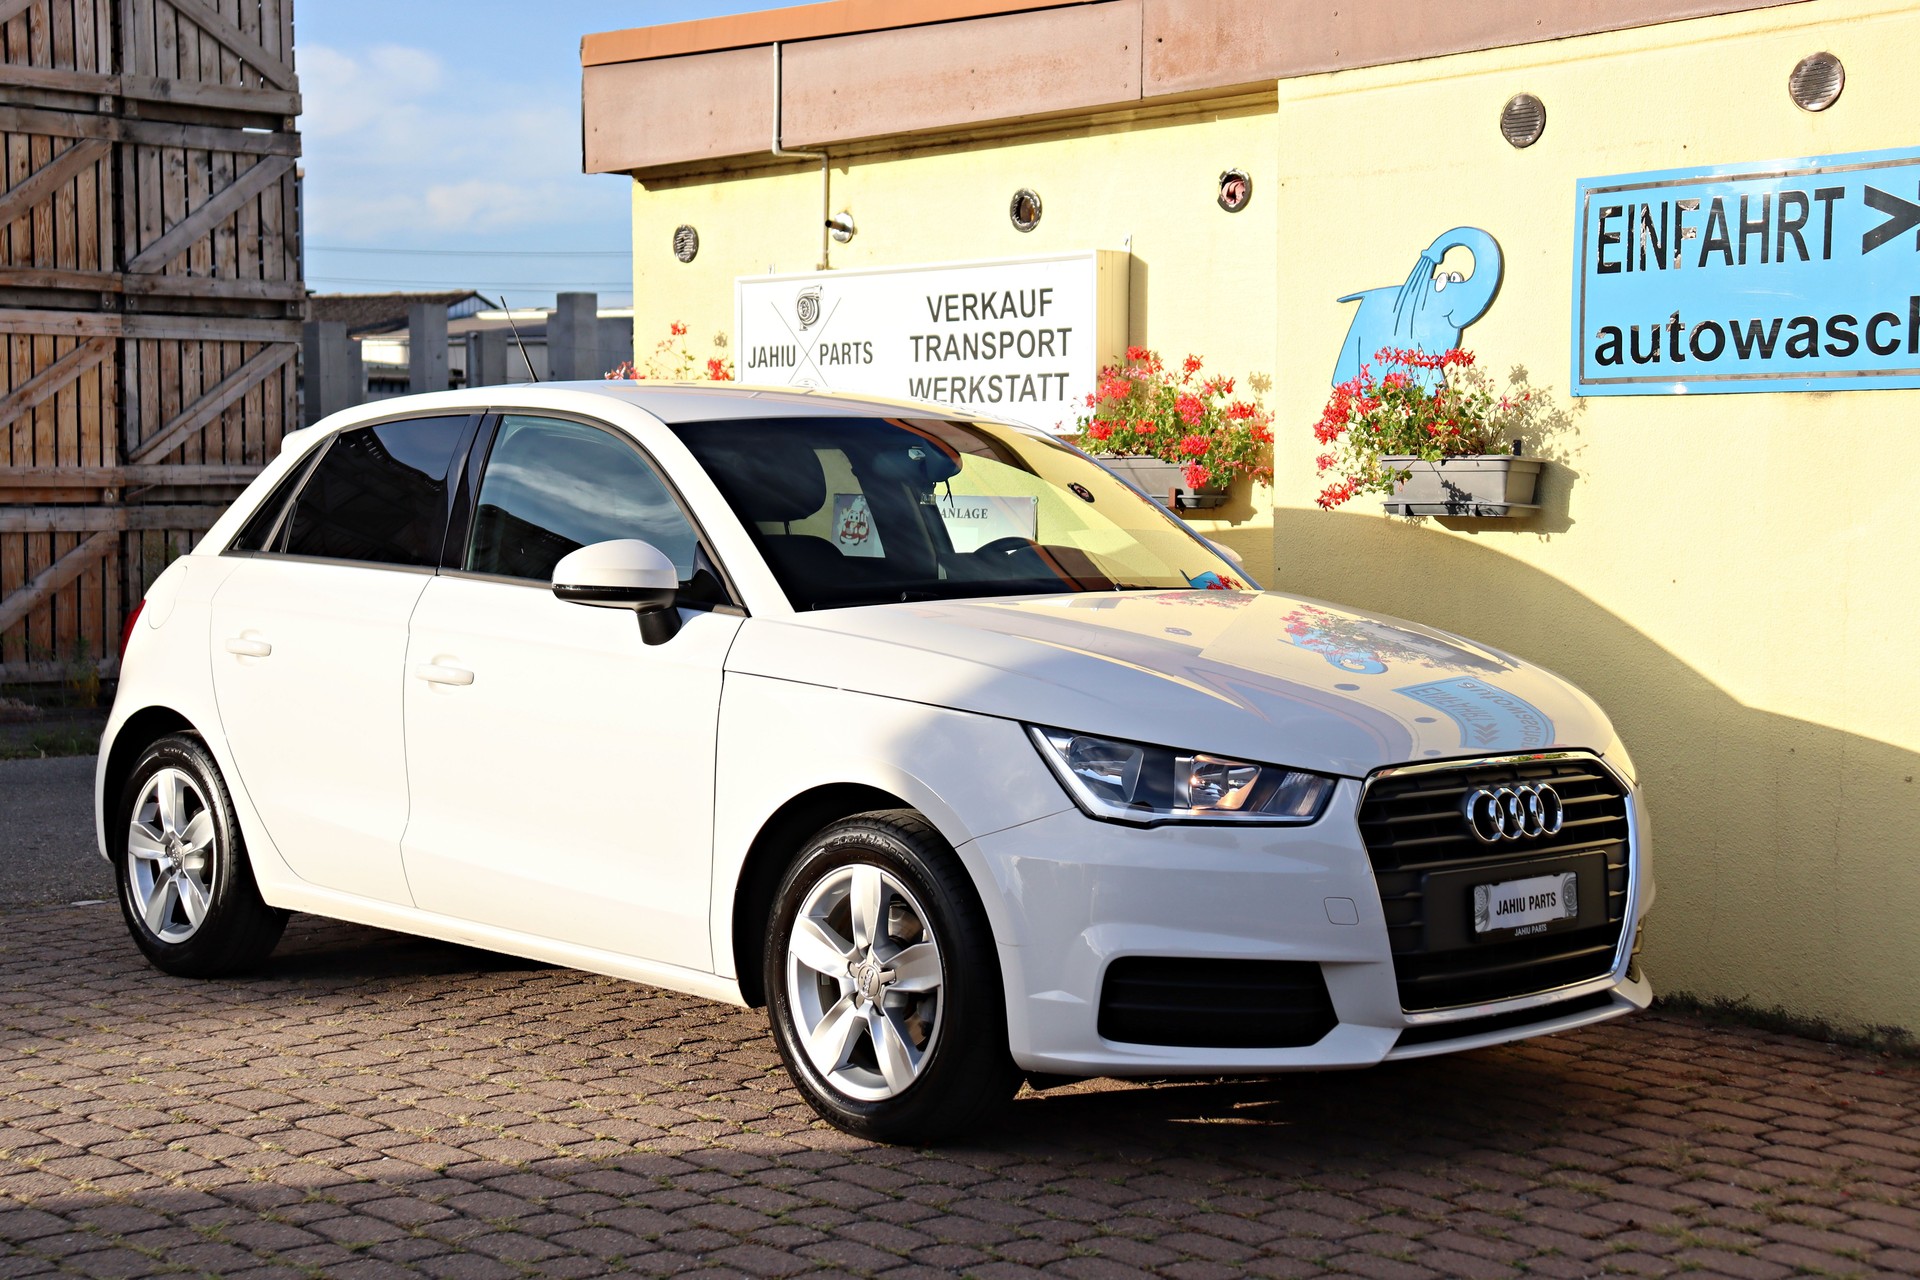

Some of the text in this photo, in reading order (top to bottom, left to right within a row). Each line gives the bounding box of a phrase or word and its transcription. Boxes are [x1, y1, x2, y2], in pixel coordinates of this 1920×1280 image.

[1597, 186, 1845, 274] EINFAHRT
[926, 288, 1053, 323] VERKAUF
[748, 341, 873, 368] JAHIU PARTS
[909, 327, 1072, 362] TRANSPORT
[908, 372, 1070, 403] WERKSTATT
[1496, 891, 1557, 916] JAHIU PARTS
[1514, 923, 1548, 937] JAHIU PARTS
